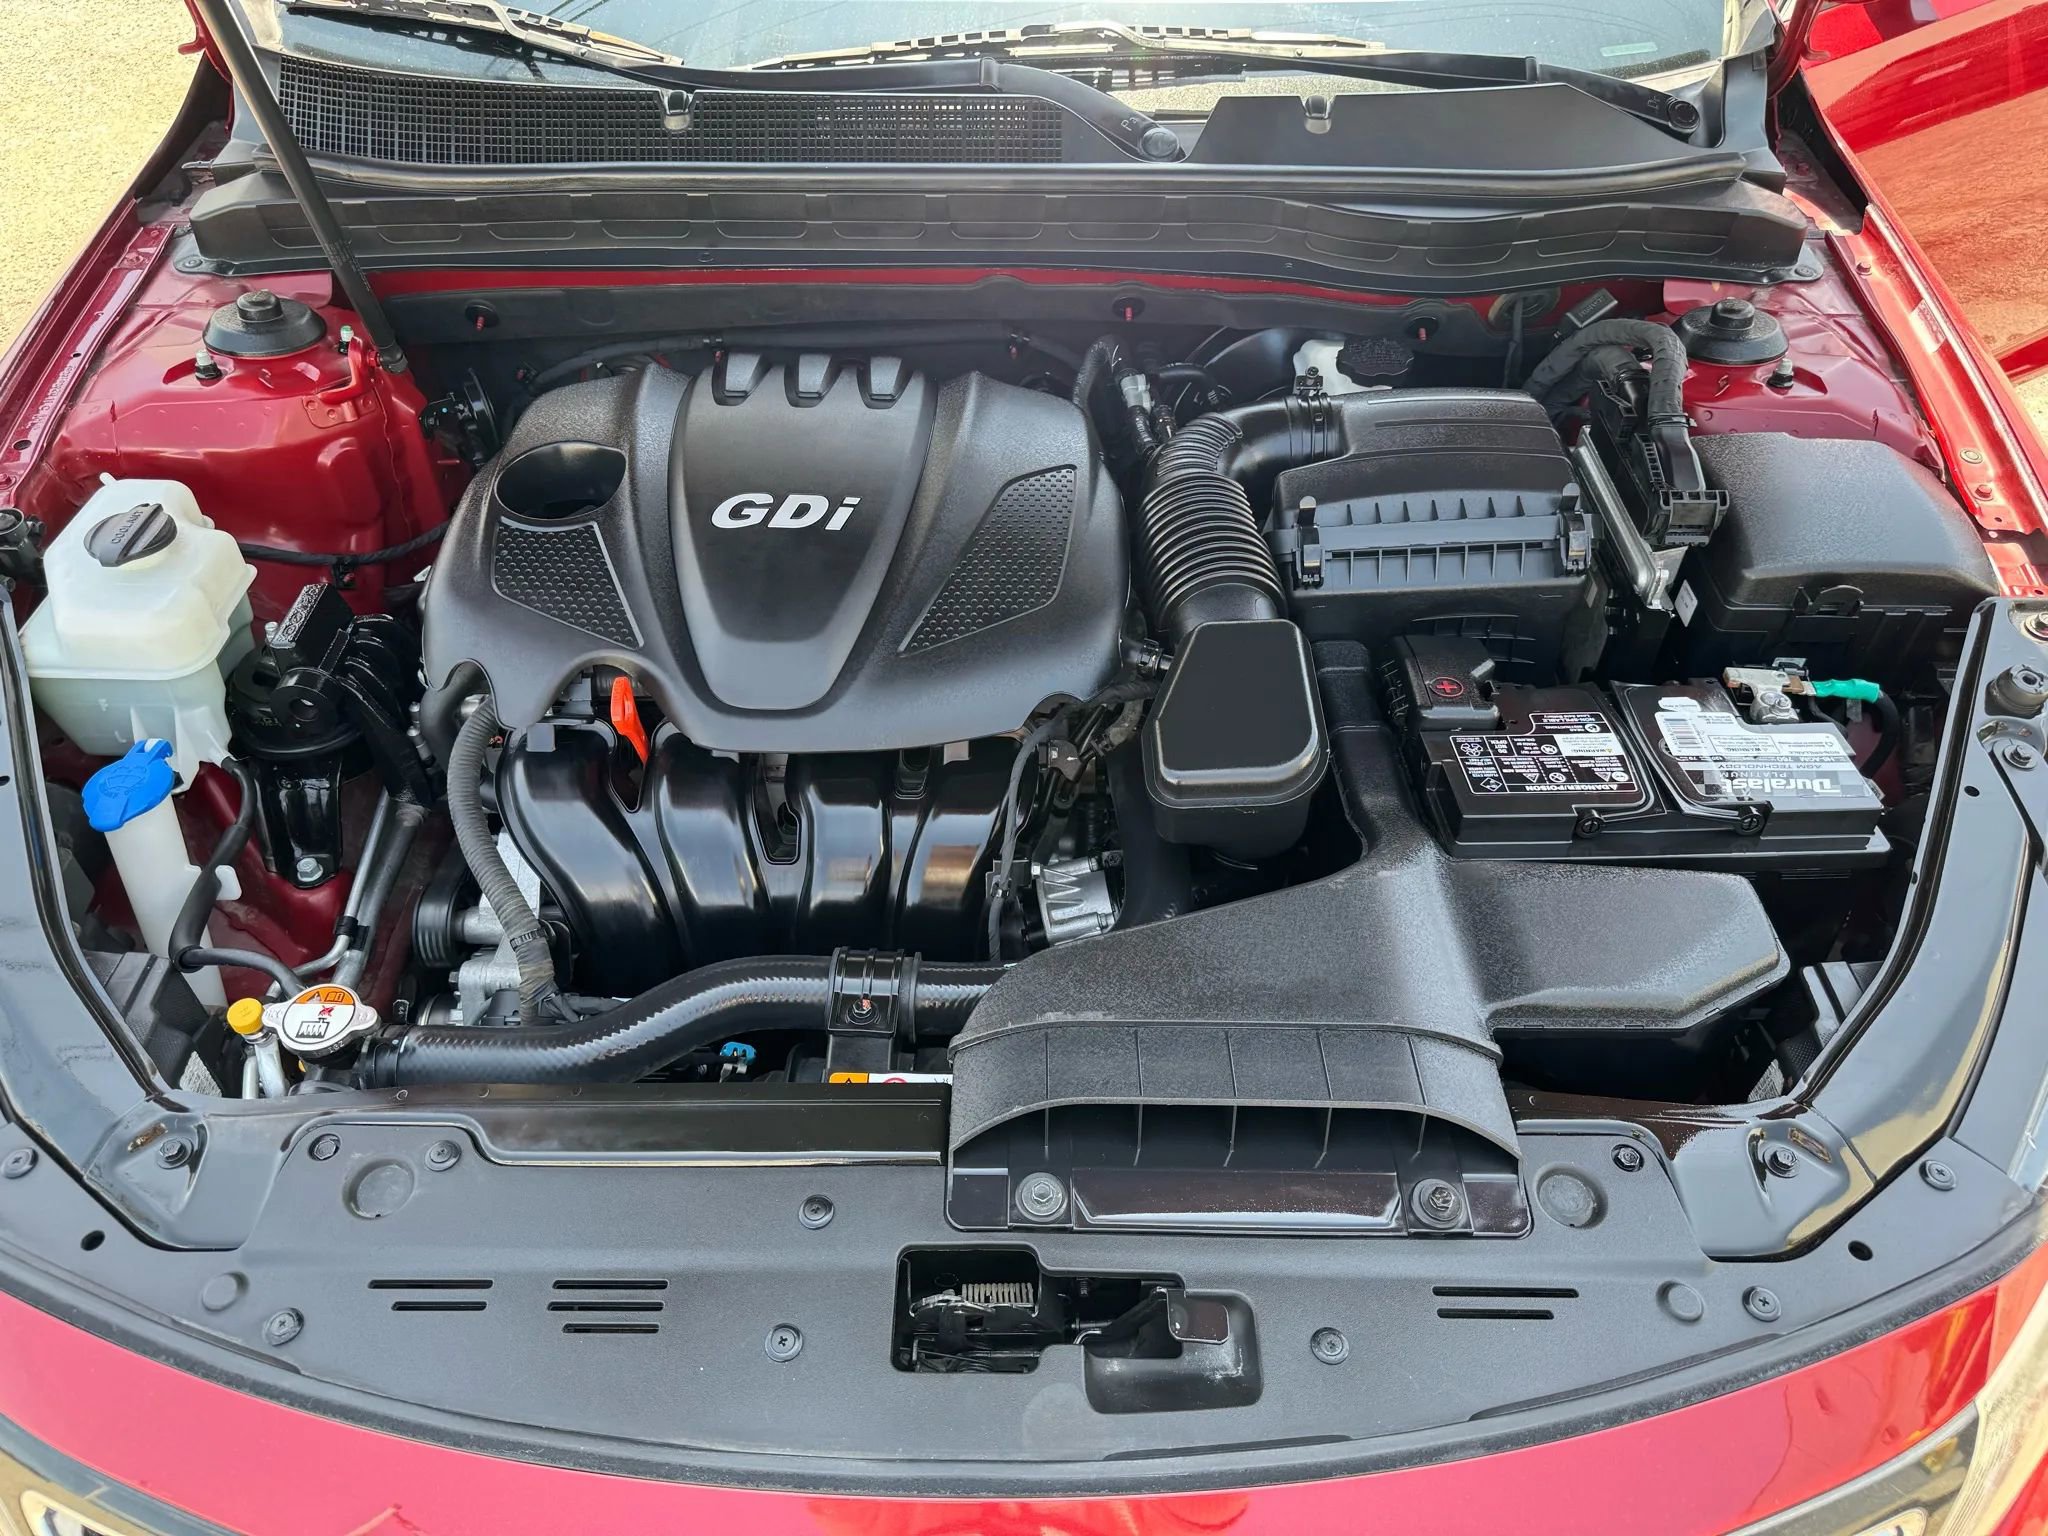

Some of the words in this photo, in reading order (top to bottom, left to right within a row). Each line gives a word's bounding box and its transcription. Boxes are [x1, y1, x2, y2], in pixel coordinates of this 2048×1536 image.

[111, 510, 144, 544] COOLANT
[711, 493, 862, 531] GDi
[1720, 778, 1841, 793] Duralast
